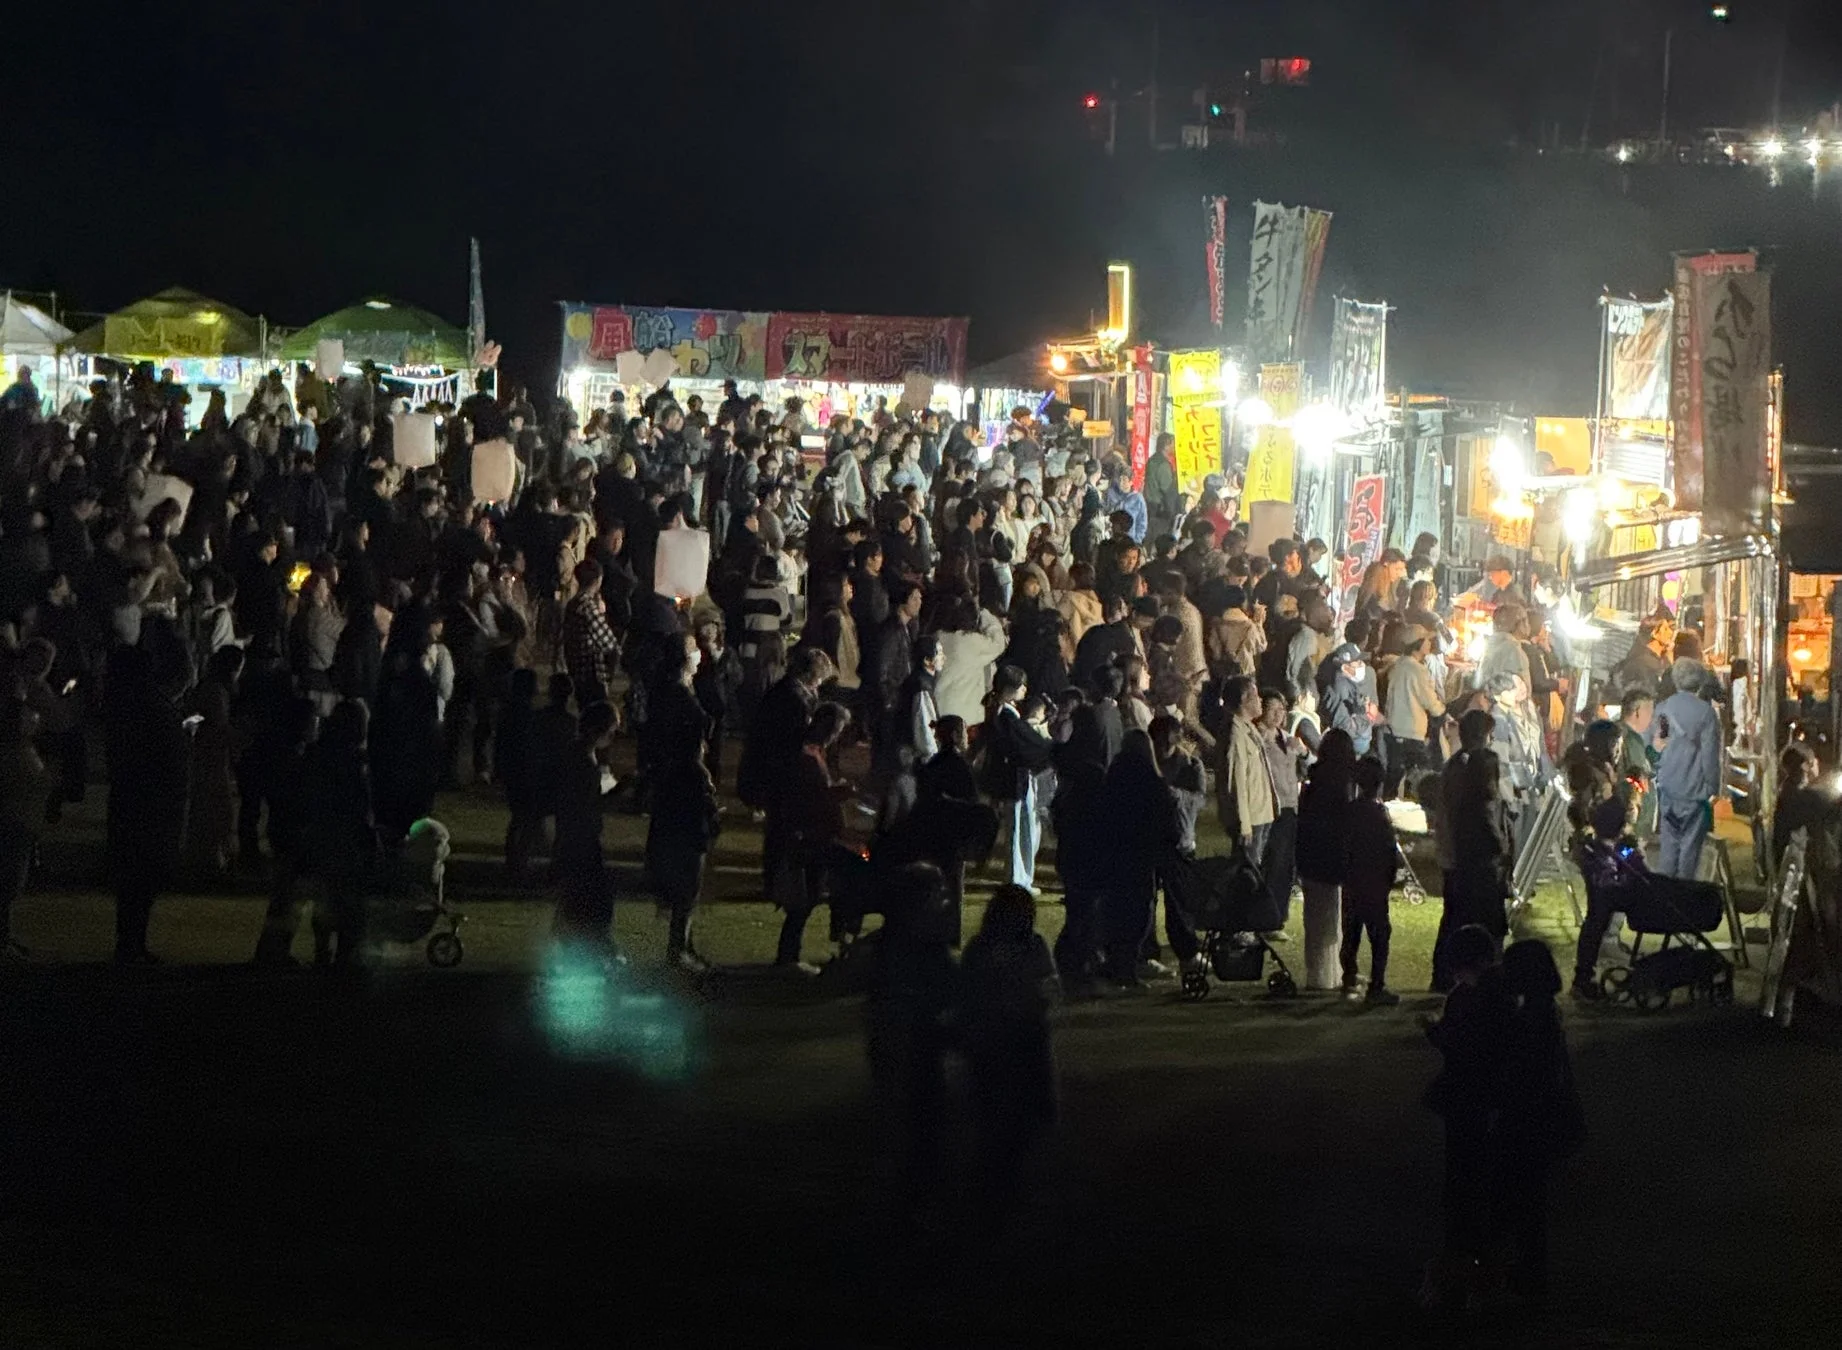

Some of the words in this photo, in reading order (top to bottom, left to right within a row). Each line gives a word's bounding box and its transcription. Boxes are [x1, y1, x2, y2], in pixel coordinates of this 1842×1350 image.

[784, 331, 948, 381] スマートボール
